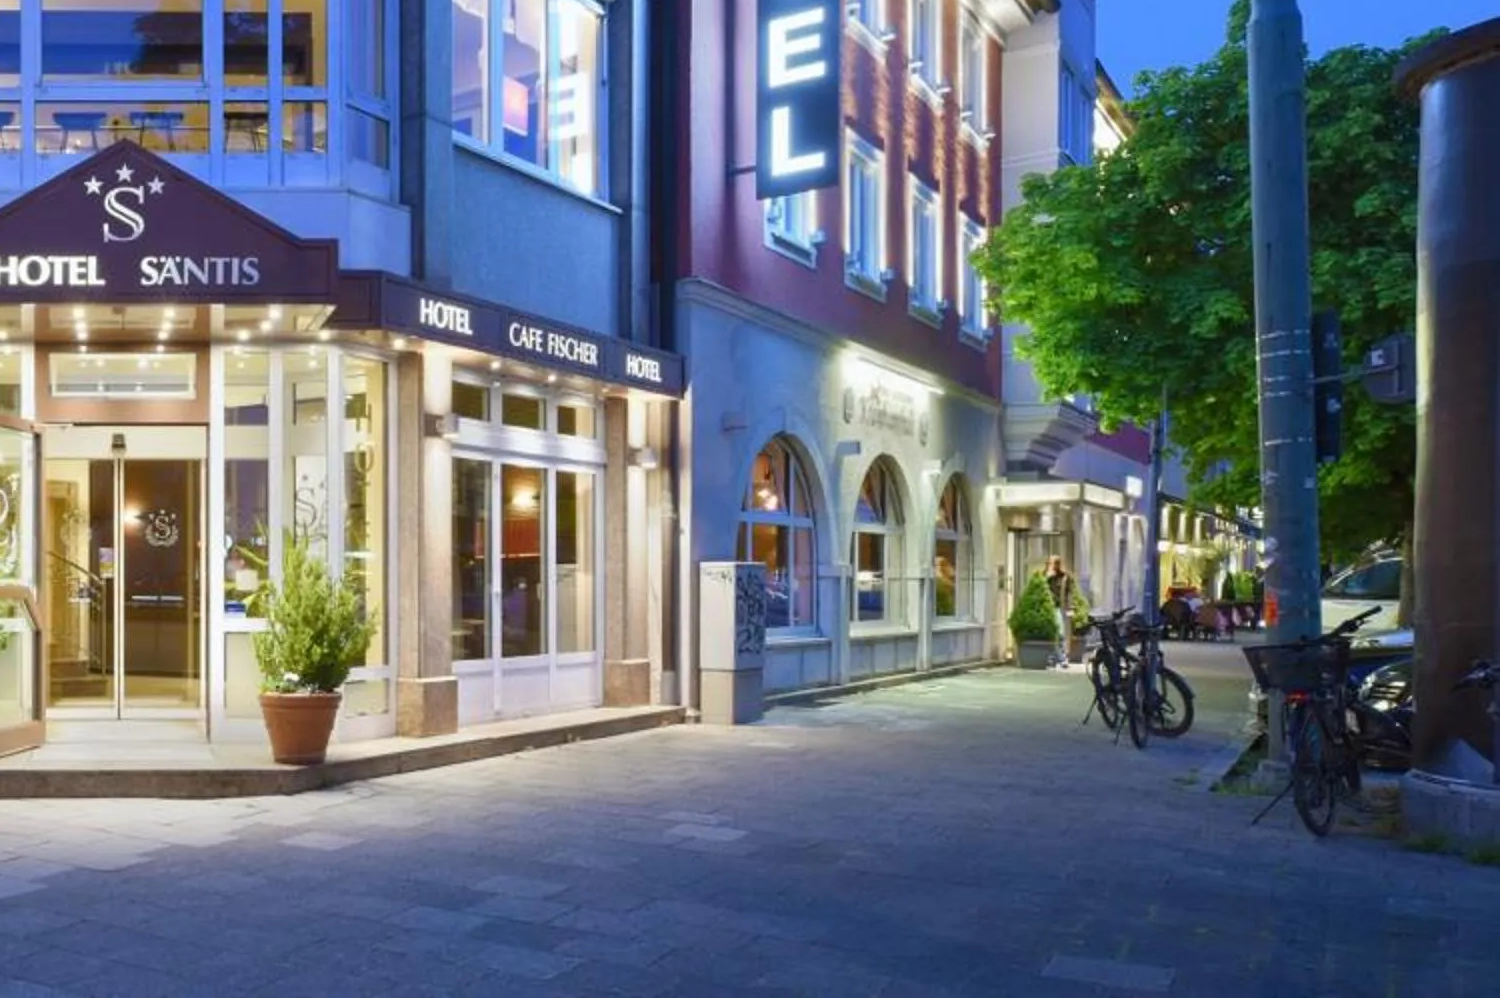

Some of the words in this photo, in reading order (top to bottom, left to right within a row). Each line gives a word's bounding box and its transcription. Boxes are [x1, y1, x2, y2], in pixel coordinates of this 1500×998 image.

[140, 254, 261, 287] SÄNTIS
[419, 298, 474, 336] HOTEL
[509, 322, 544, 353] CAFE
[547, 332, 599, 367] FISCHER
[625, 353, 663, 383] HOTEL
